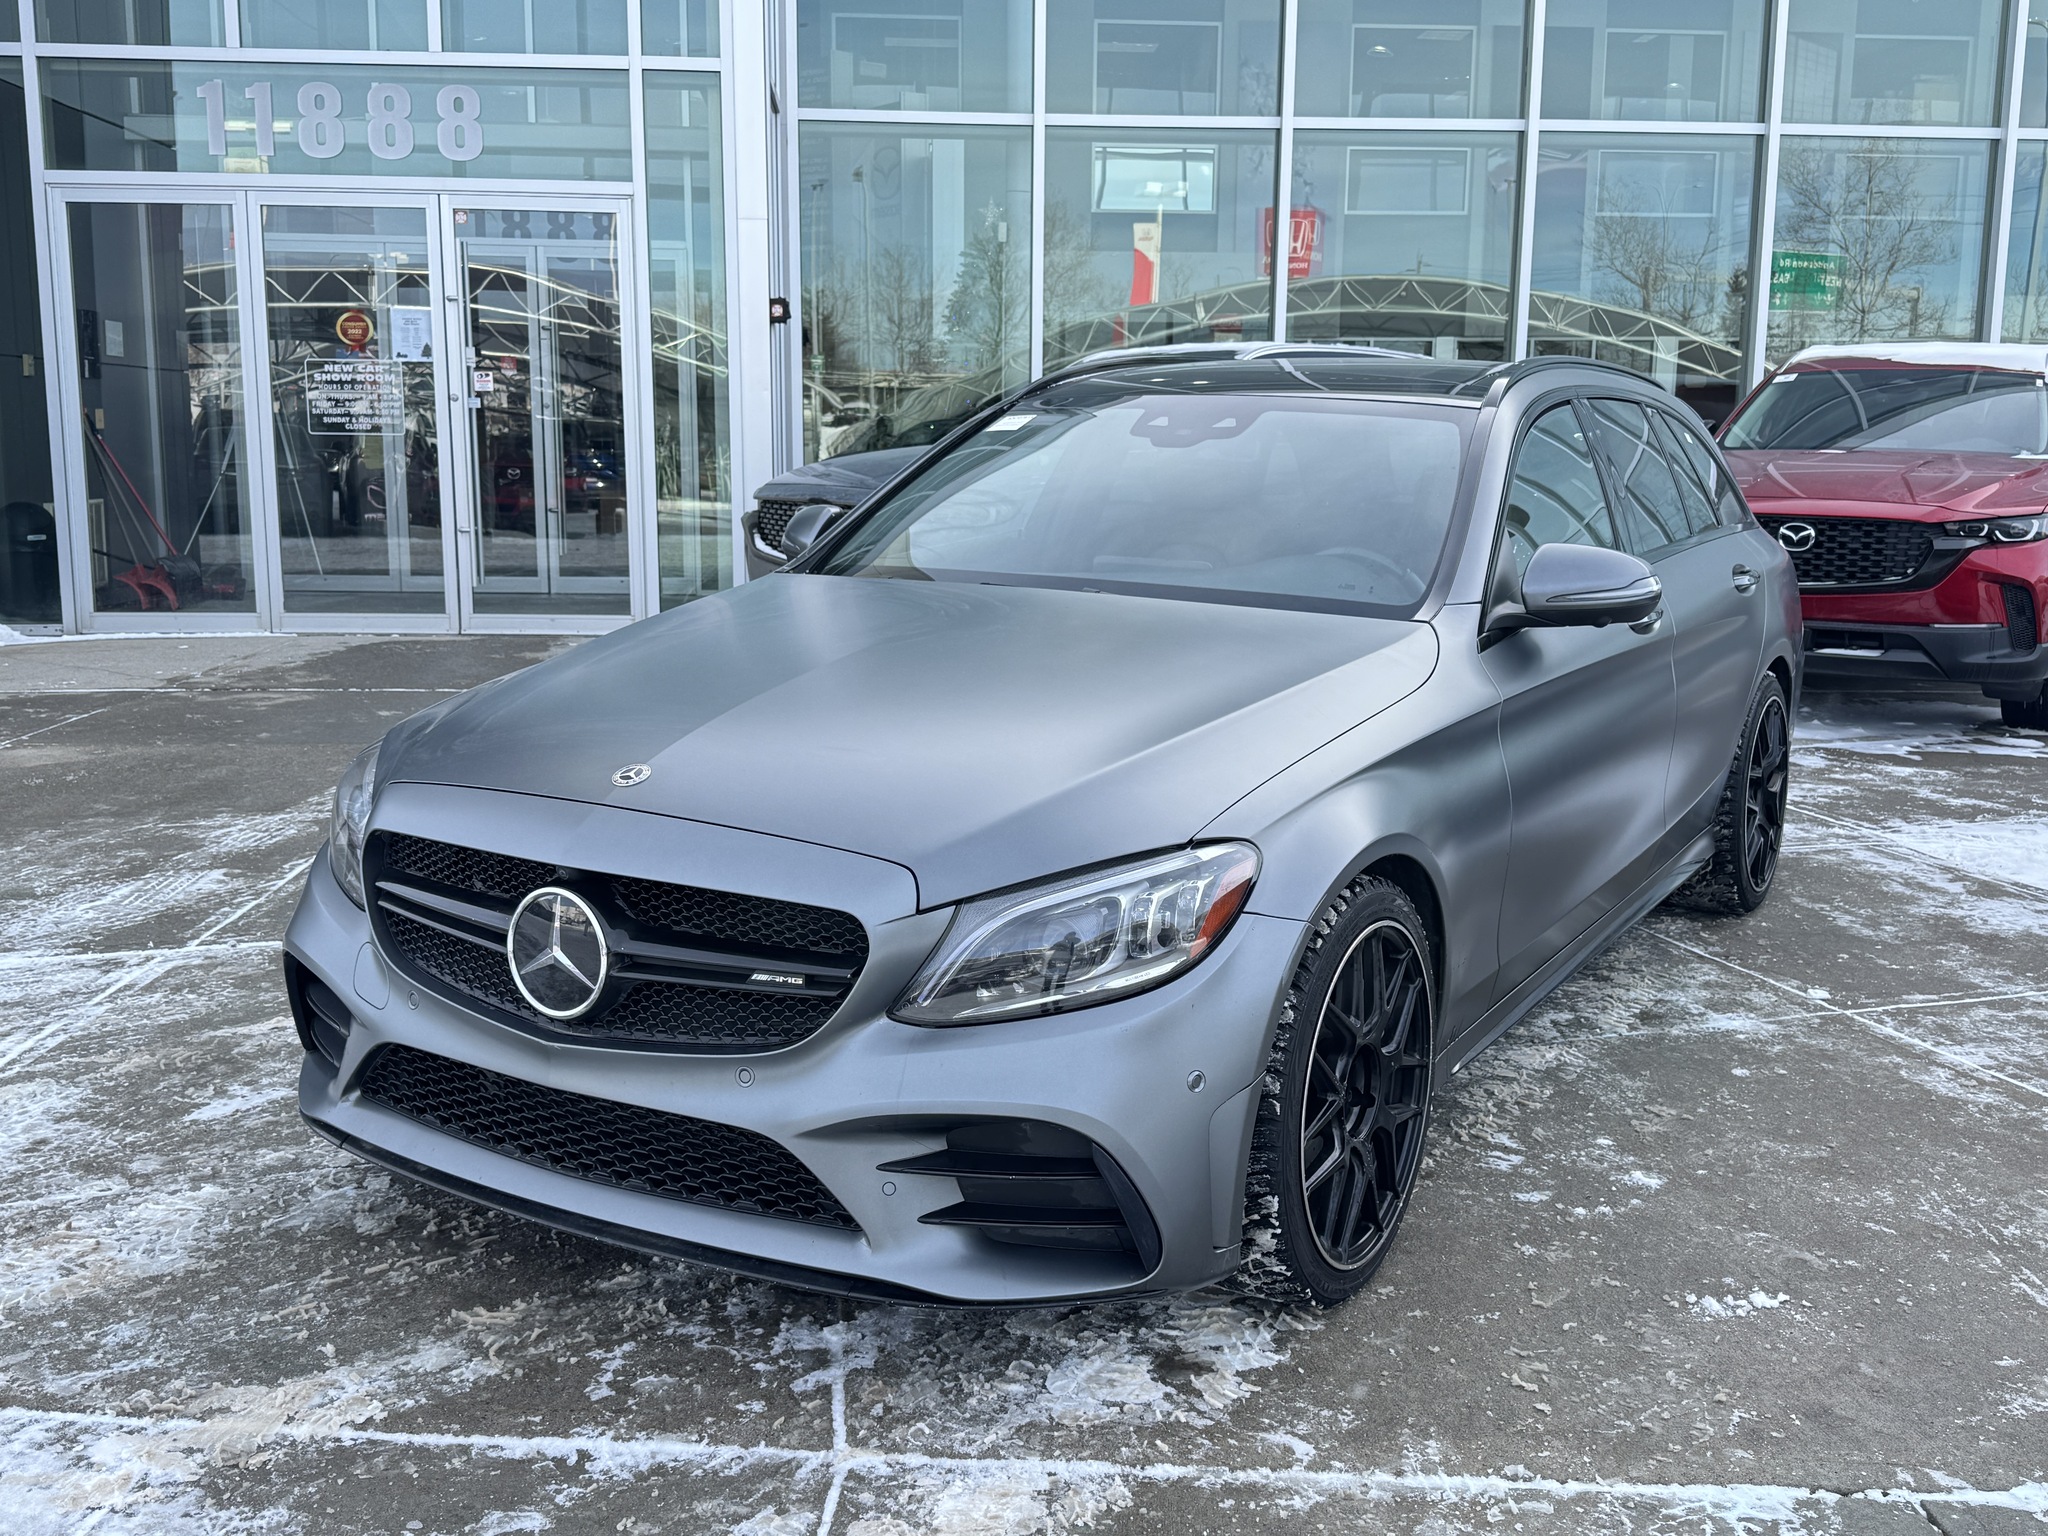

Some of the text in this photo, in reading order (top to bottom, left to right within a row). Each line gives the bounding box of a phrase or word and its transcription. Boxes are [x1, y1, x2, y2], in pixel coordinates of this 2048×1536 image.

[196, 79, 484, 162] 11888
[324, 364, 384, 372] NEW CAR
[313, 373, 395, 382] SHOW ROOM
[767, 975, 803, 985] AMG
